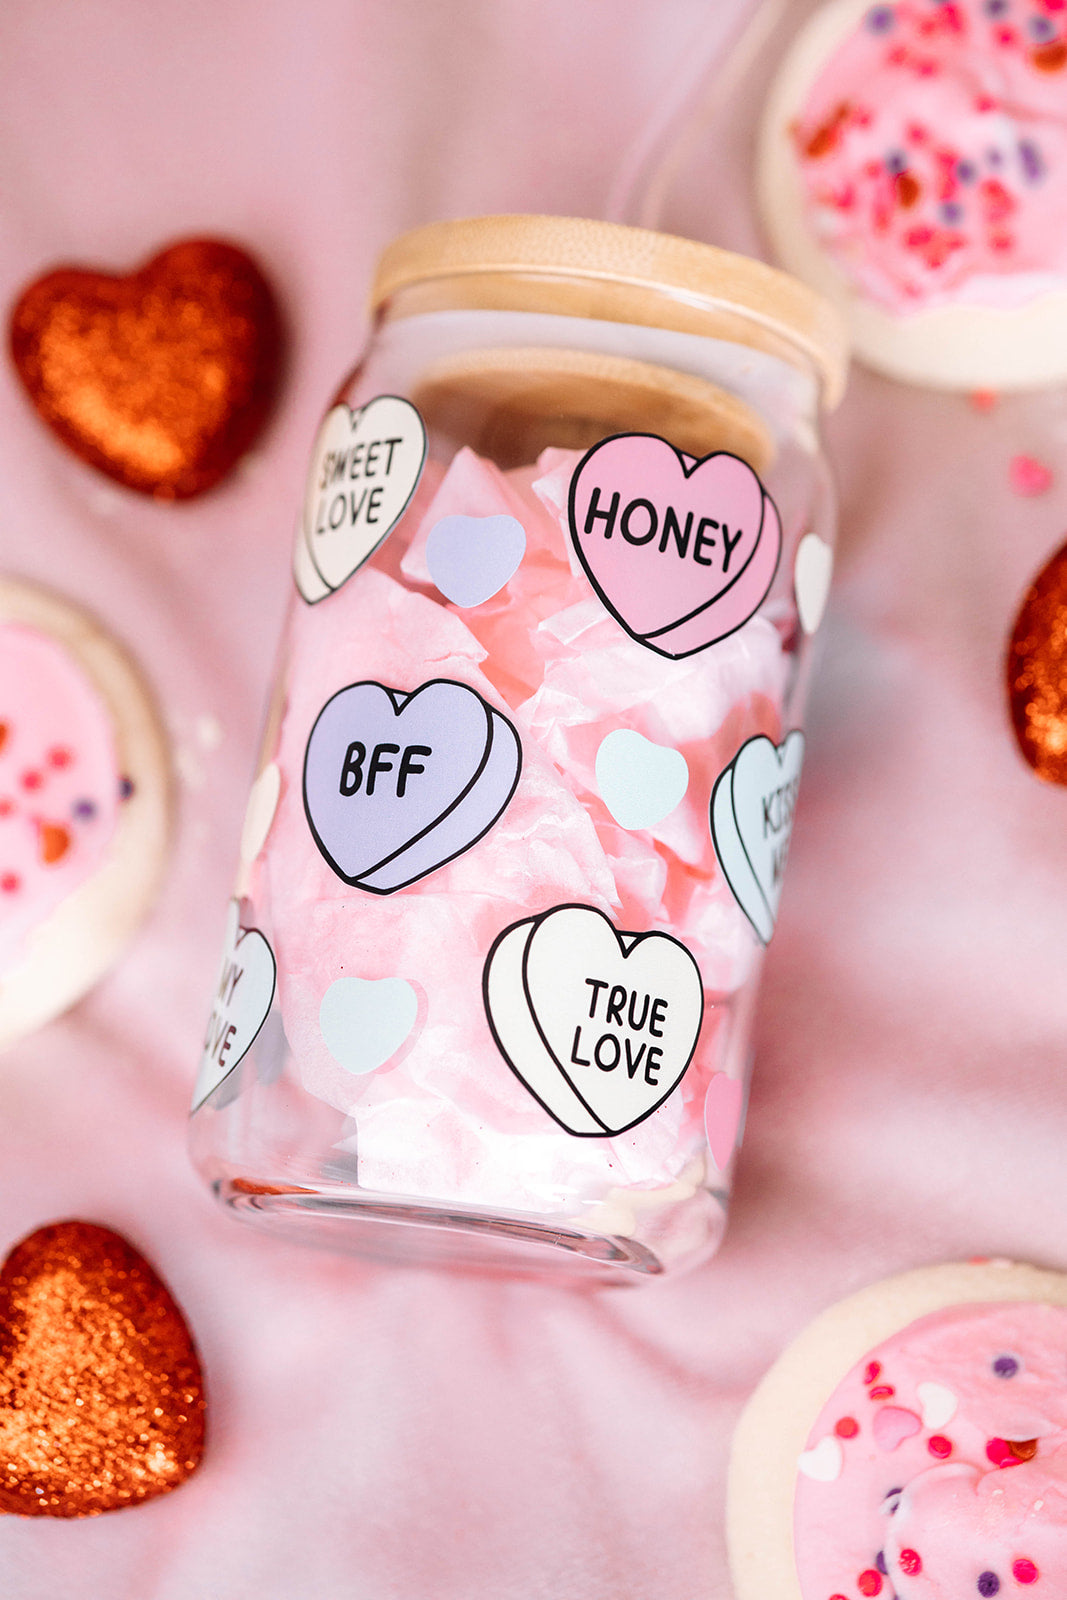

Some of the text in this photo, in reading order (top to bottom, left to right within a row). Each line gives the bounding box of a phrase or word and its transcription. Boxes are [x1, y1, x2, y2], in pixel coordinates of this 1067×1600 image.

[320, 438, 403, 490] SWEET
[315, 487, 384, 535] LOVE
[583, 487, 743, 573] HONEY
[339, 741, 432, 798] BFF
[585, 978, 668, 1038] TRUE
[203, 1012, 237, 1068] OVE
[570, 1025, 664, 1086] LOVE
